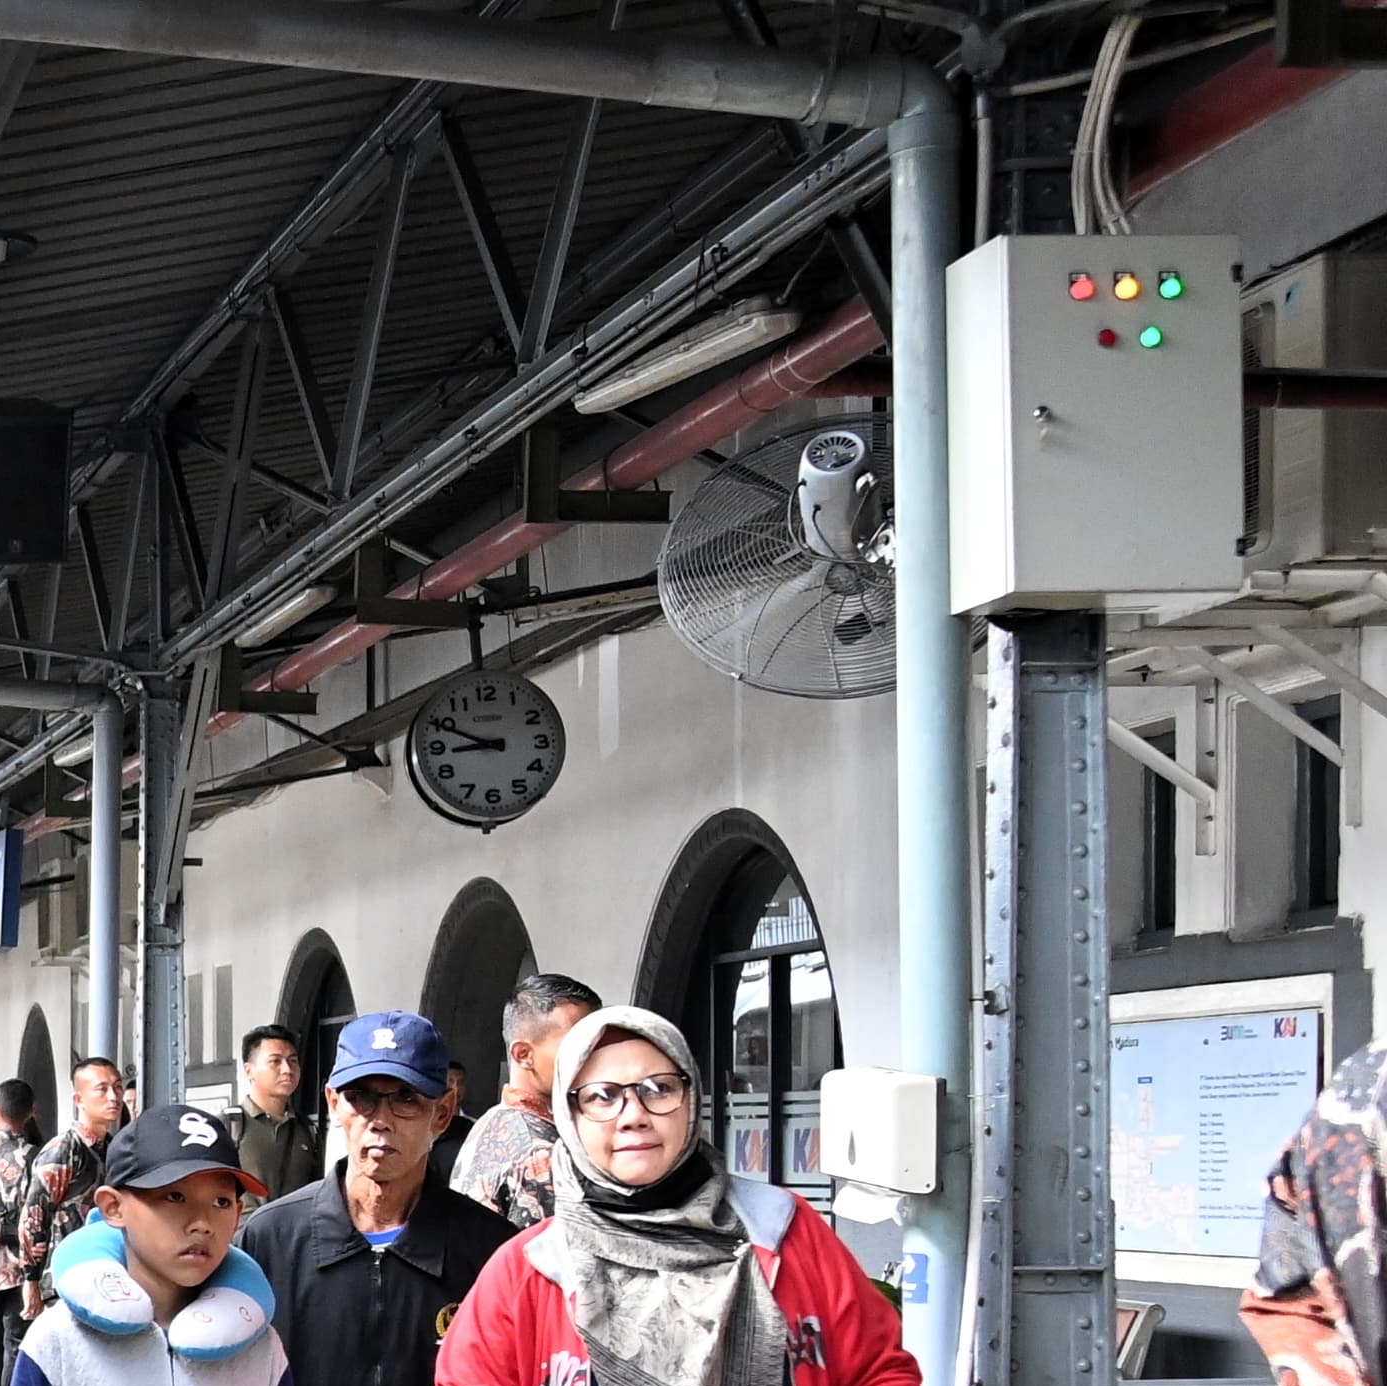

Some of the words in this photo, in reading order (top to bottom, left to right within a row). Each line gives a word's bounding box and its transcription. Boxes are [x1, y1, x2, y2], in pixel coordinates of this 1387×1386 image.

[476, 685, 497, 702] 12
[509, 691, 516, 706] 1
[449, 697, 468, 712] 11
[433, 717, 456, 732] 10
[525, 710, 540, 725] 2
[429, 740, 446, 755] 9
[533, 734, 550, 749] 3
[438, 765, 455, 779] 8
[526, 758, 544, 773] 4
[459, 784, 476, 799] 7
[511, 779, 528, 794] 5
[484, 789, 501, 804] 6
[179, 1112, 218, 1148] S
[794, 1128, 820, 1173] KA
